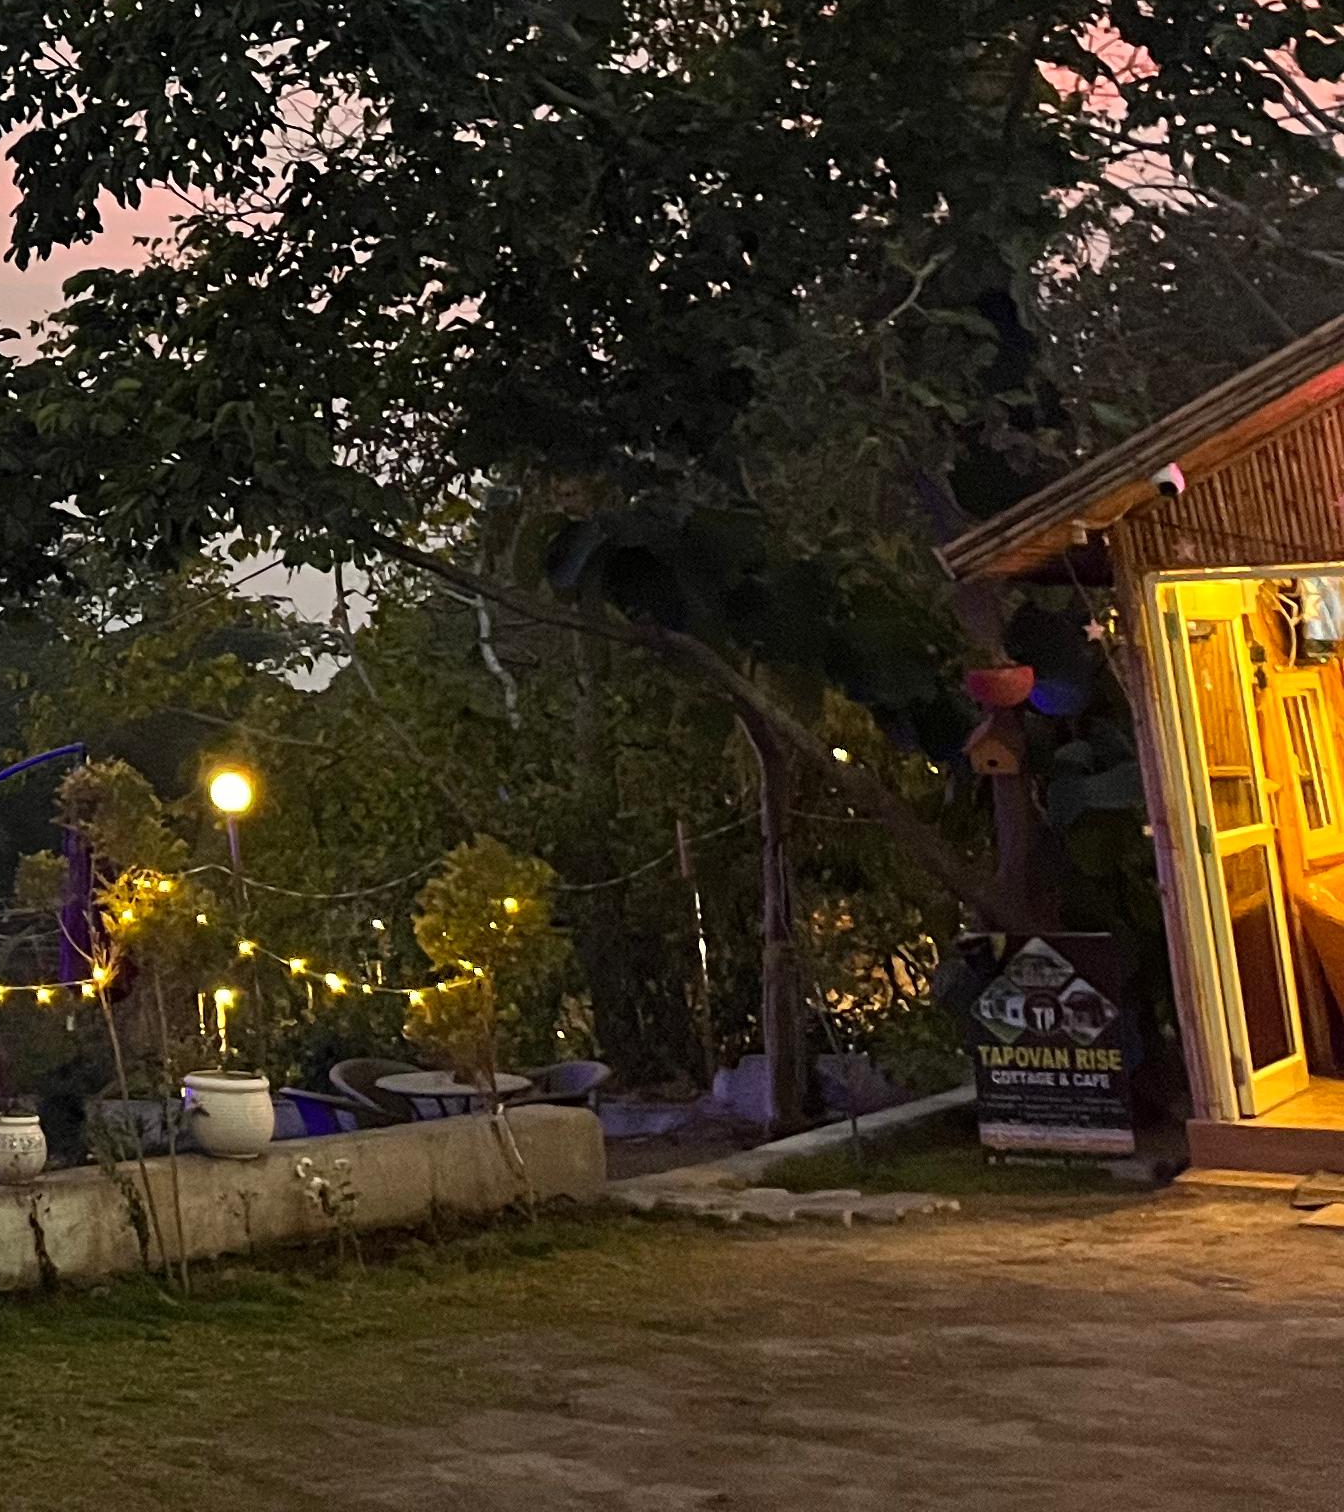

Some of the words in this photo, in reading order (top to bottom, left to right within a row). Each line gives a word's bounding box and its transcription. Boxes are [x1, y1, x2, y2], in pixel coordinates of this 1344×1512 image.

[978, 1044, 1071, 1070] TAPOVAN
[1075, 1048, 1124, 1072] RISE
[991, 1069, 1056, 1086] COTTAGE
[1059, 1071, 1070, 1086] &
[1072, 1073, 1111, 1089] CAFE
